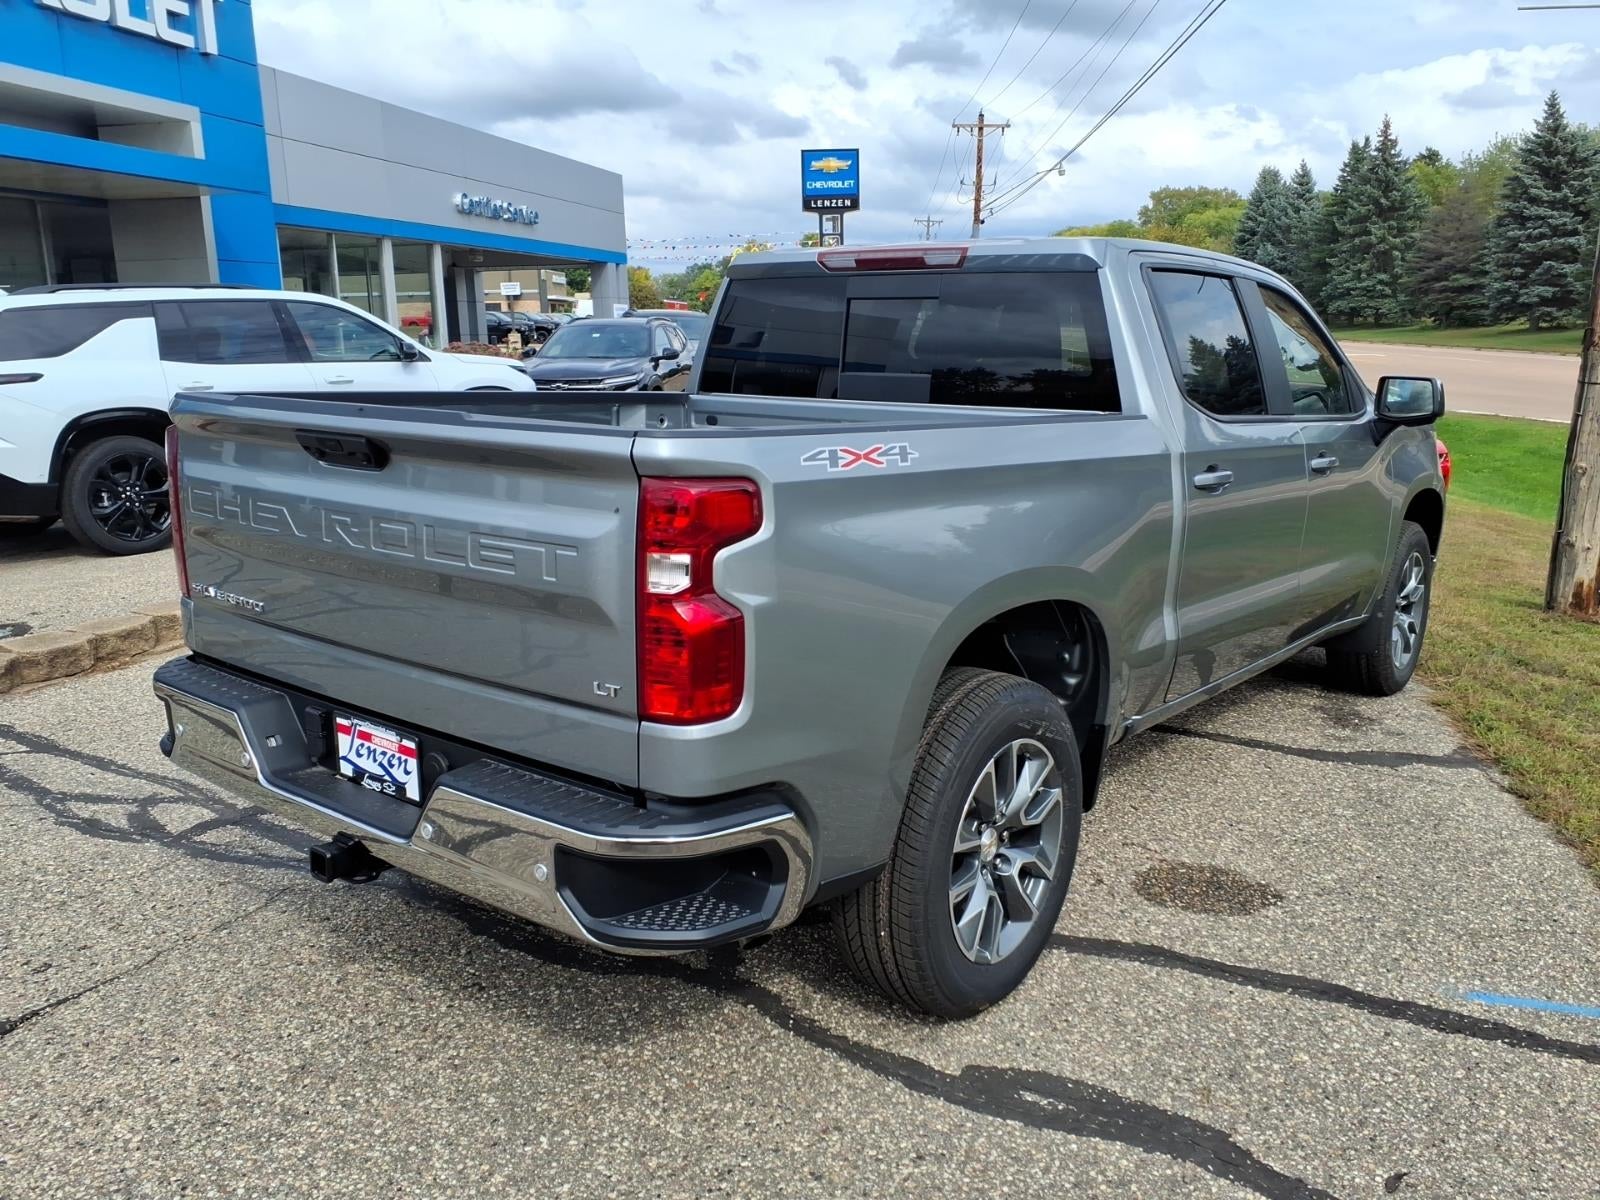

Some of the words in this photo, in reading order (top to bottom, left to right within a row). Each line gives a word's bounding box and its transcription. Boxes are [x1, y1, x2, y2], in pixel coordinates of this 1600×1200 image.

[806, 180, 855, 189] CHEVROLET
[455, 192, 504, 220] Certified
[503, 202, 540, 225] Service
[811, 199, 852, 208] LENZEN
[188, 485, 578, 581] CHEVROLET
[191, 582, 265, 612] SILVERADO
[593, 681, 622, 698] LT
[339, 722, 416, 786] Lenzen
